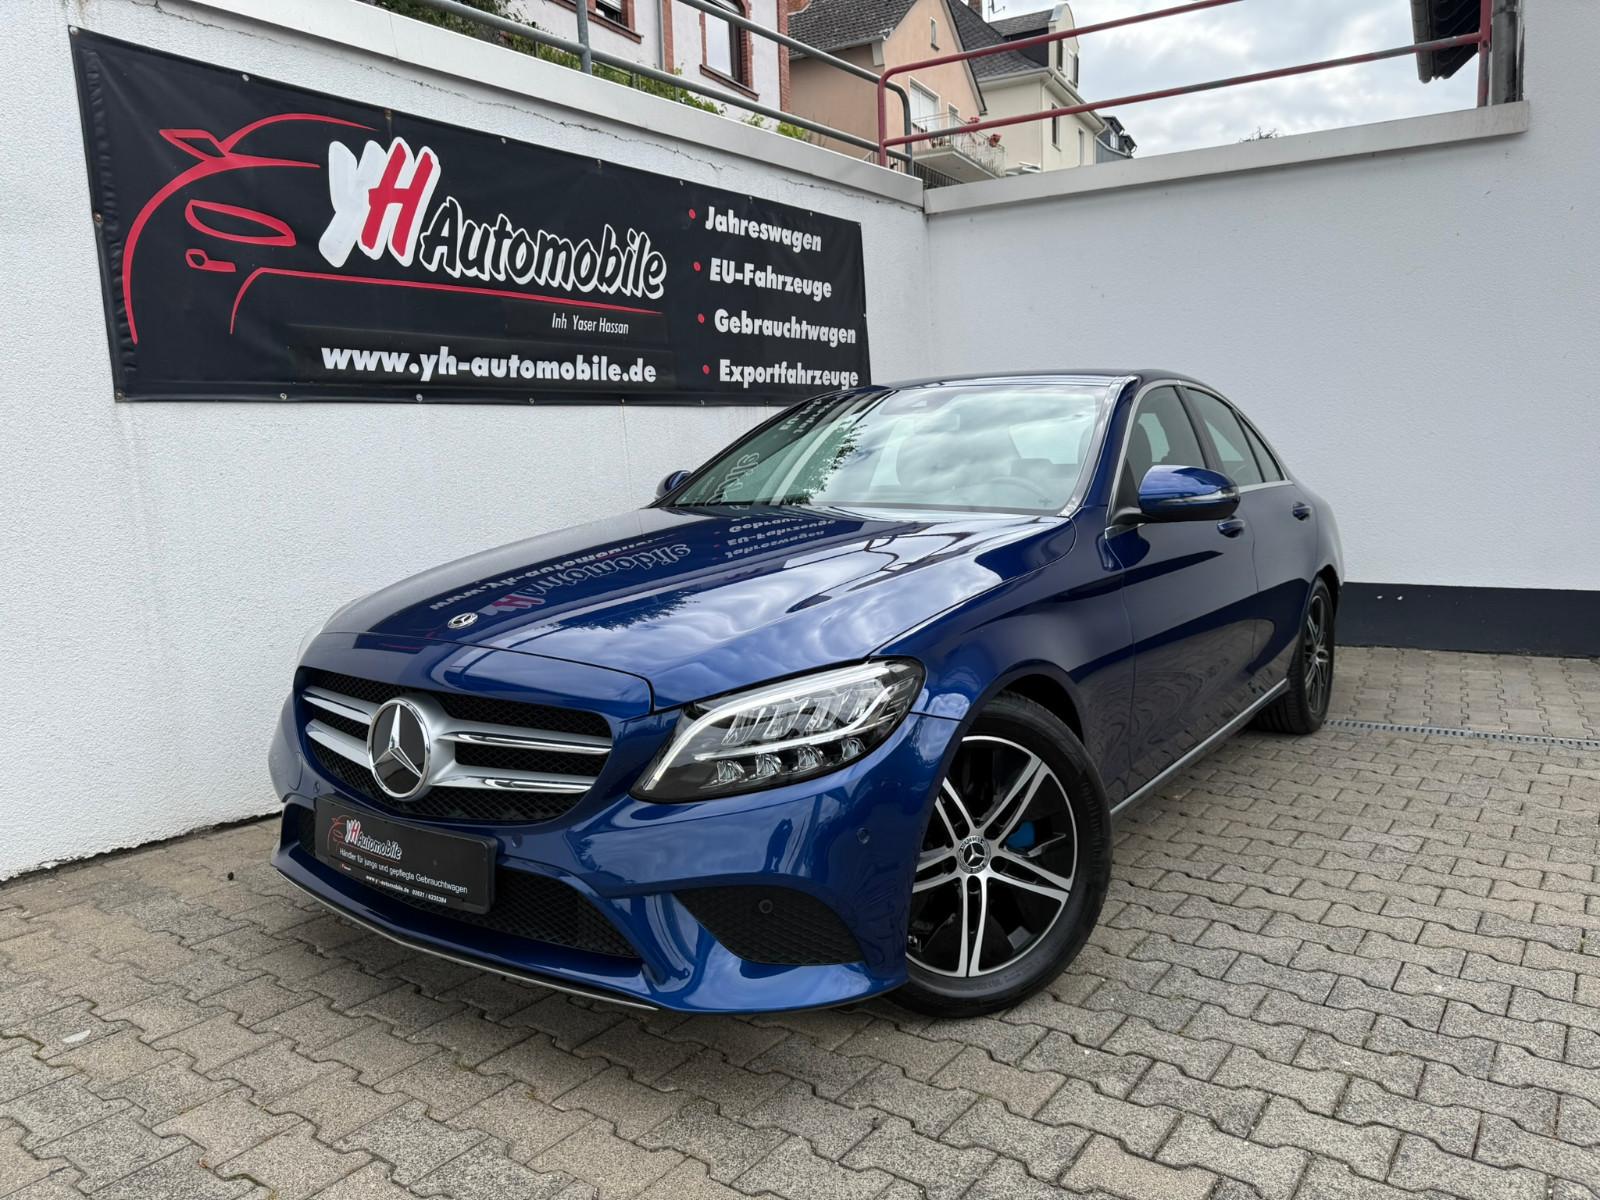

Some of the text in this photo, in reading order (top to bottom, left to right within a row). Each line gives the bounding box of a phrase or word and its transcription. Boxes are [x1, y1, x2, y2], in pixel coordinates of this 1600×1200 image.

[318, 136, 667, 300] YH Automobile
[705, 206, 822, 253] Jahreswagen
[709, 257, 832, 302] EU-Fahrzeuge
[552, 312, 629, 334] Inh Yaser Hassan
[714, 308, 856, 347] Gebrauchtwagen
[321, 345, 657, 382] www.yh-automobile.de
[719, 359, 859, 391] Exportfahrzeuge
[416, 873, 468, 894] Gebrauchtwagen
